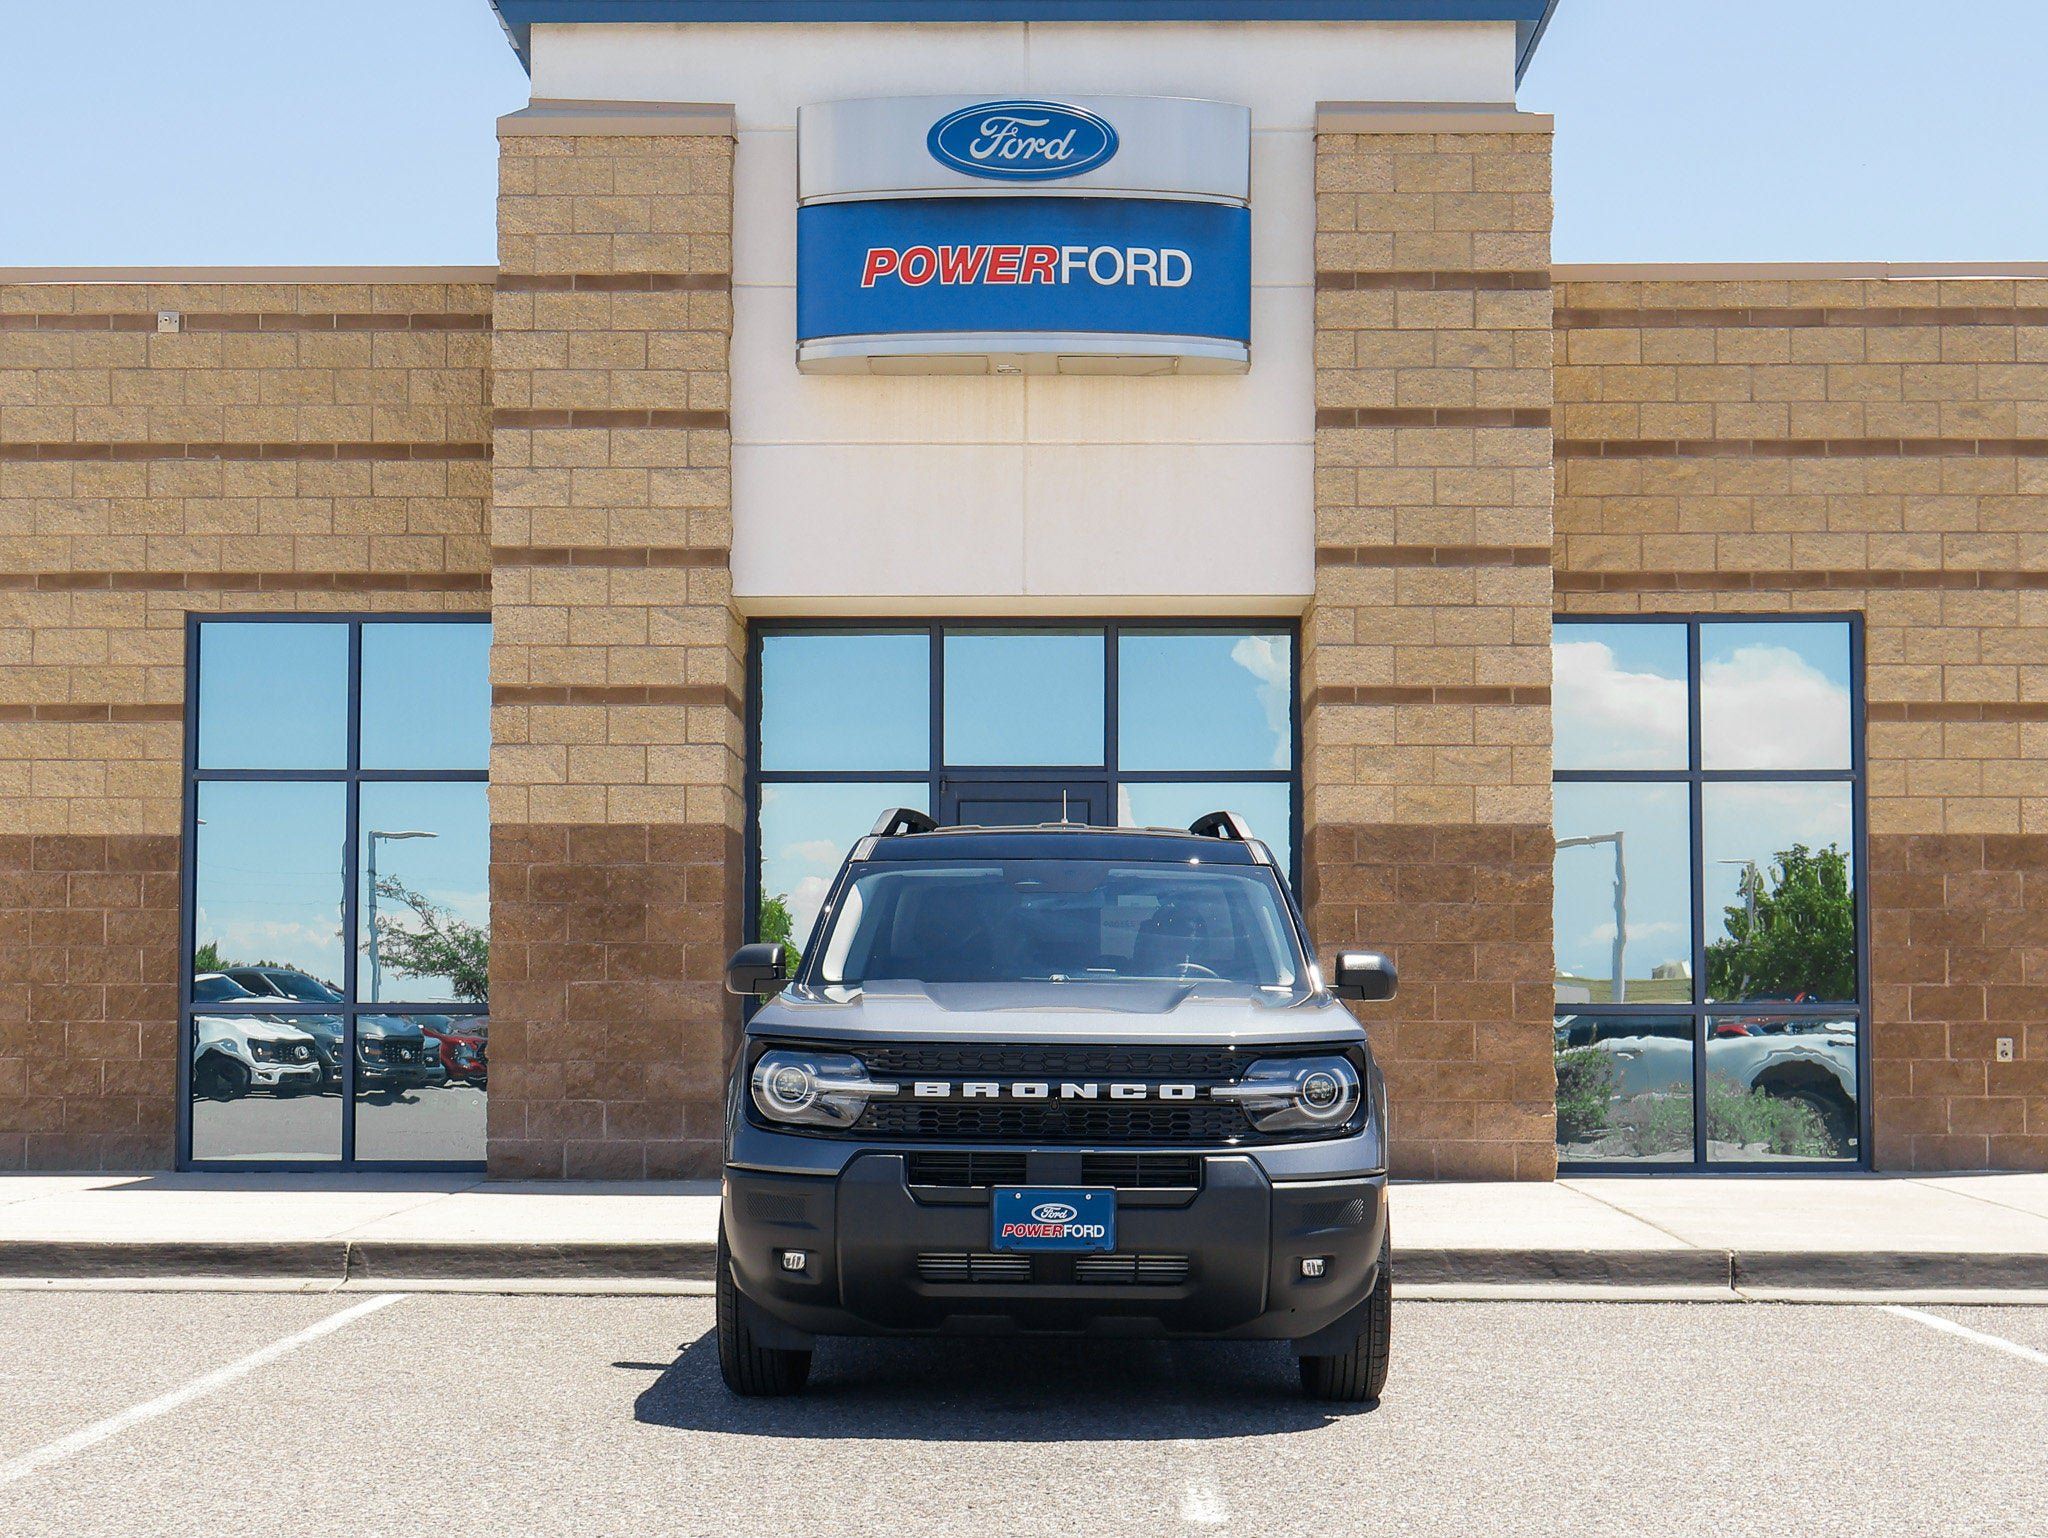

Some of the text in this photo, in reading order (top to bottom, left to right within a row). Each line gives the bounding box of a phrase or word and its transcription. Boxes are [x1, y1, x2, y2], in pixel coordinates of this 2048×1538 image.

[969, 116, 1076, 160] Ford
[914, 1082, 1196, 1100] BRONCO
[1040, 1206, 1068, 1220] Ford
